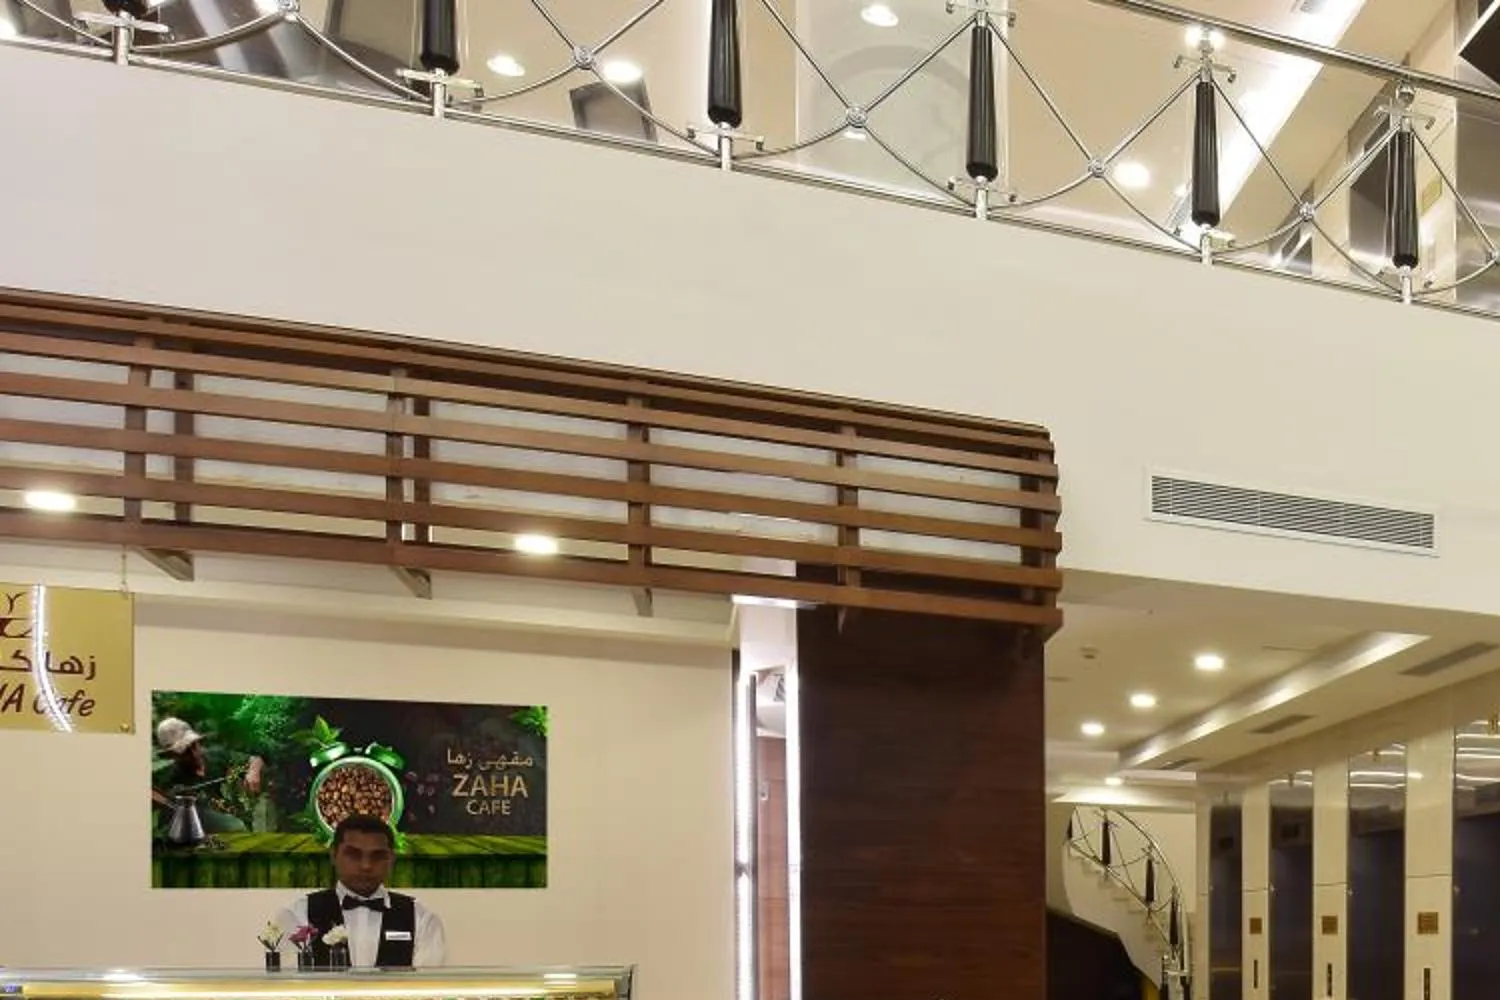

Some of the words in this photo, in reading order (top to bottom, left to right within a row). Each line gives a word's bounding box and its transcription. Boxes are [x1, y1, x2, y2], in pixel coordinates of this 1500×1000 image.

[447, 747, 473, 769] زها
[452, 774, 529, 798] ZAHA
[466, 800, 511, 815] CAFE
